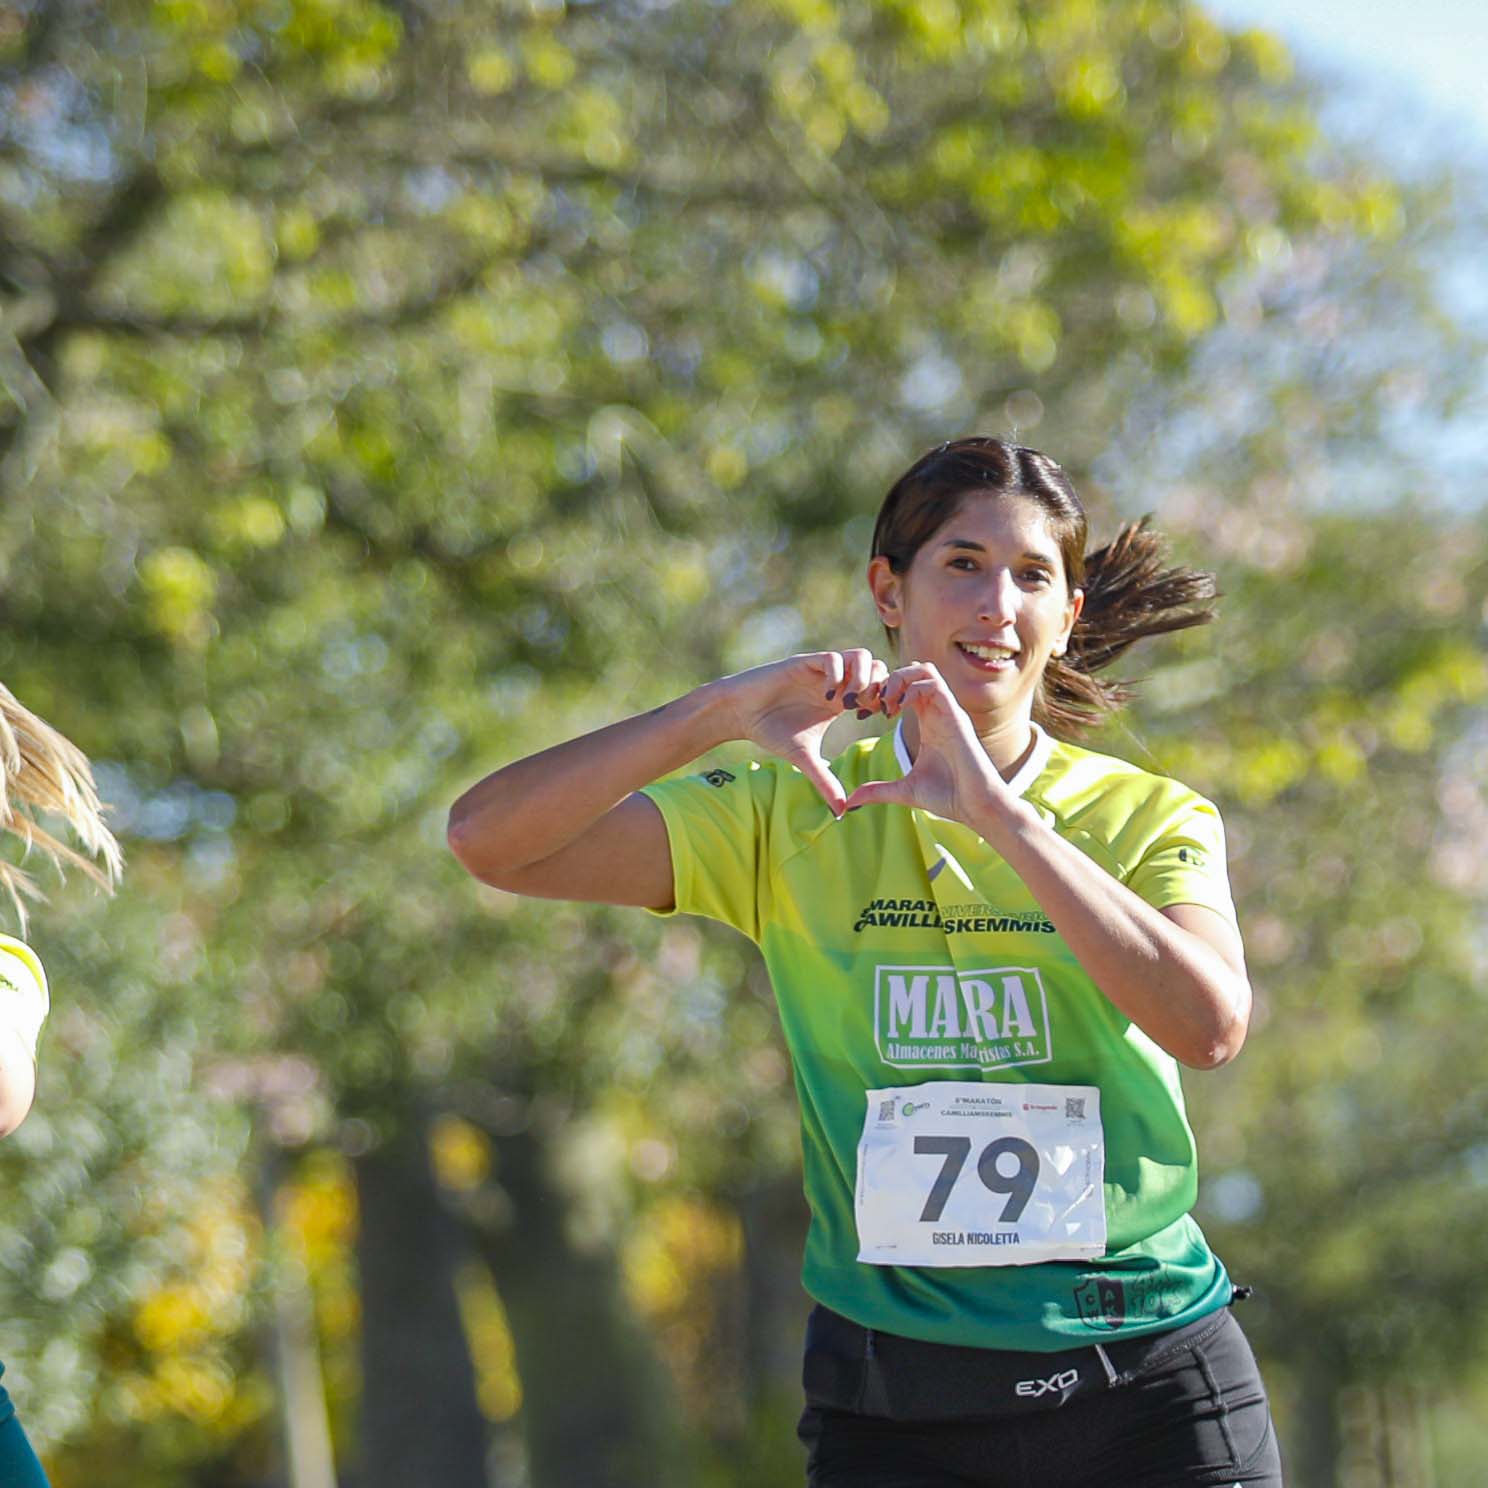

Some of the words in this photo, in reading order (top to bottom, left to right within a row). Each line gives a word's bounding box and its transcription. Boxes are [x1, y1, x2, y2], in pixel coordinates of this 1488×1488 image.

[870, 899, 938, 912] MARAT
[887, 1042, 957, 1060] Almacenes
[1014, 1041, 1040, 1057] S.A.
[914, 1136, 1040, 1222] 79
[932, 1232, 965, 1245] GISELA
[967, 1232, 1020, 1245] NICOLETTA
[1015, 1369, 1078, 1397] EXO
